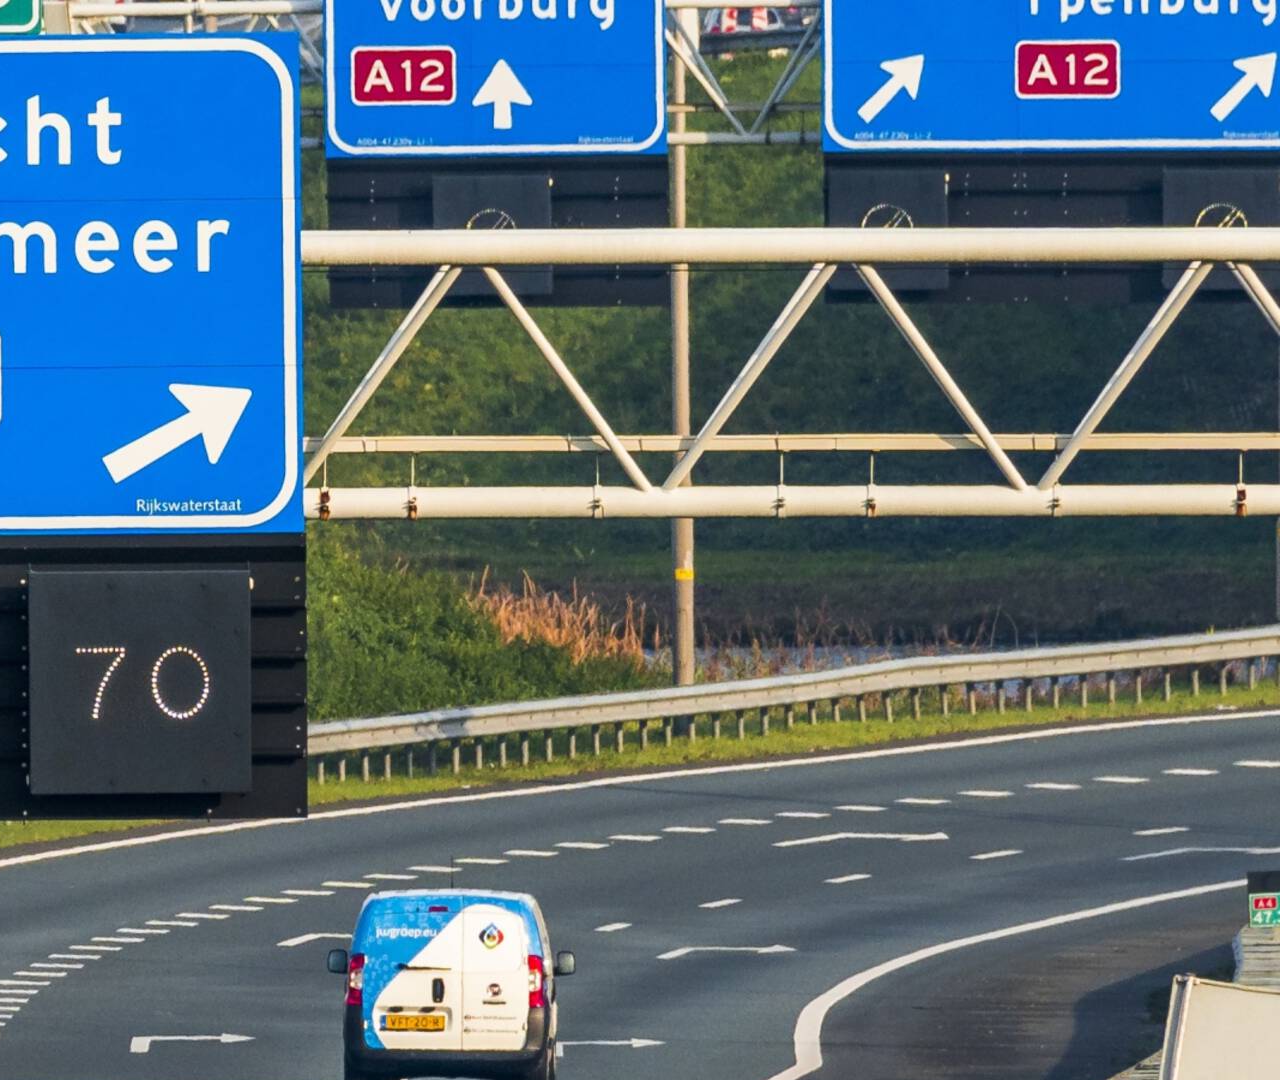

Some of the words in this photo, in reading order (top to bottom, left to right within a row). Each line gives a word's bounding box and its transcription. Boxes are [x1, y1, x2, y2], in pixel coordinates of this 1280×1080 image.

[363, 59, 445, 92] A12
[1027, 53, 1109, 86] A12
[136, 498, 242, 516] Rijkswaterstaat
[75, 646, 211, 719] 70
